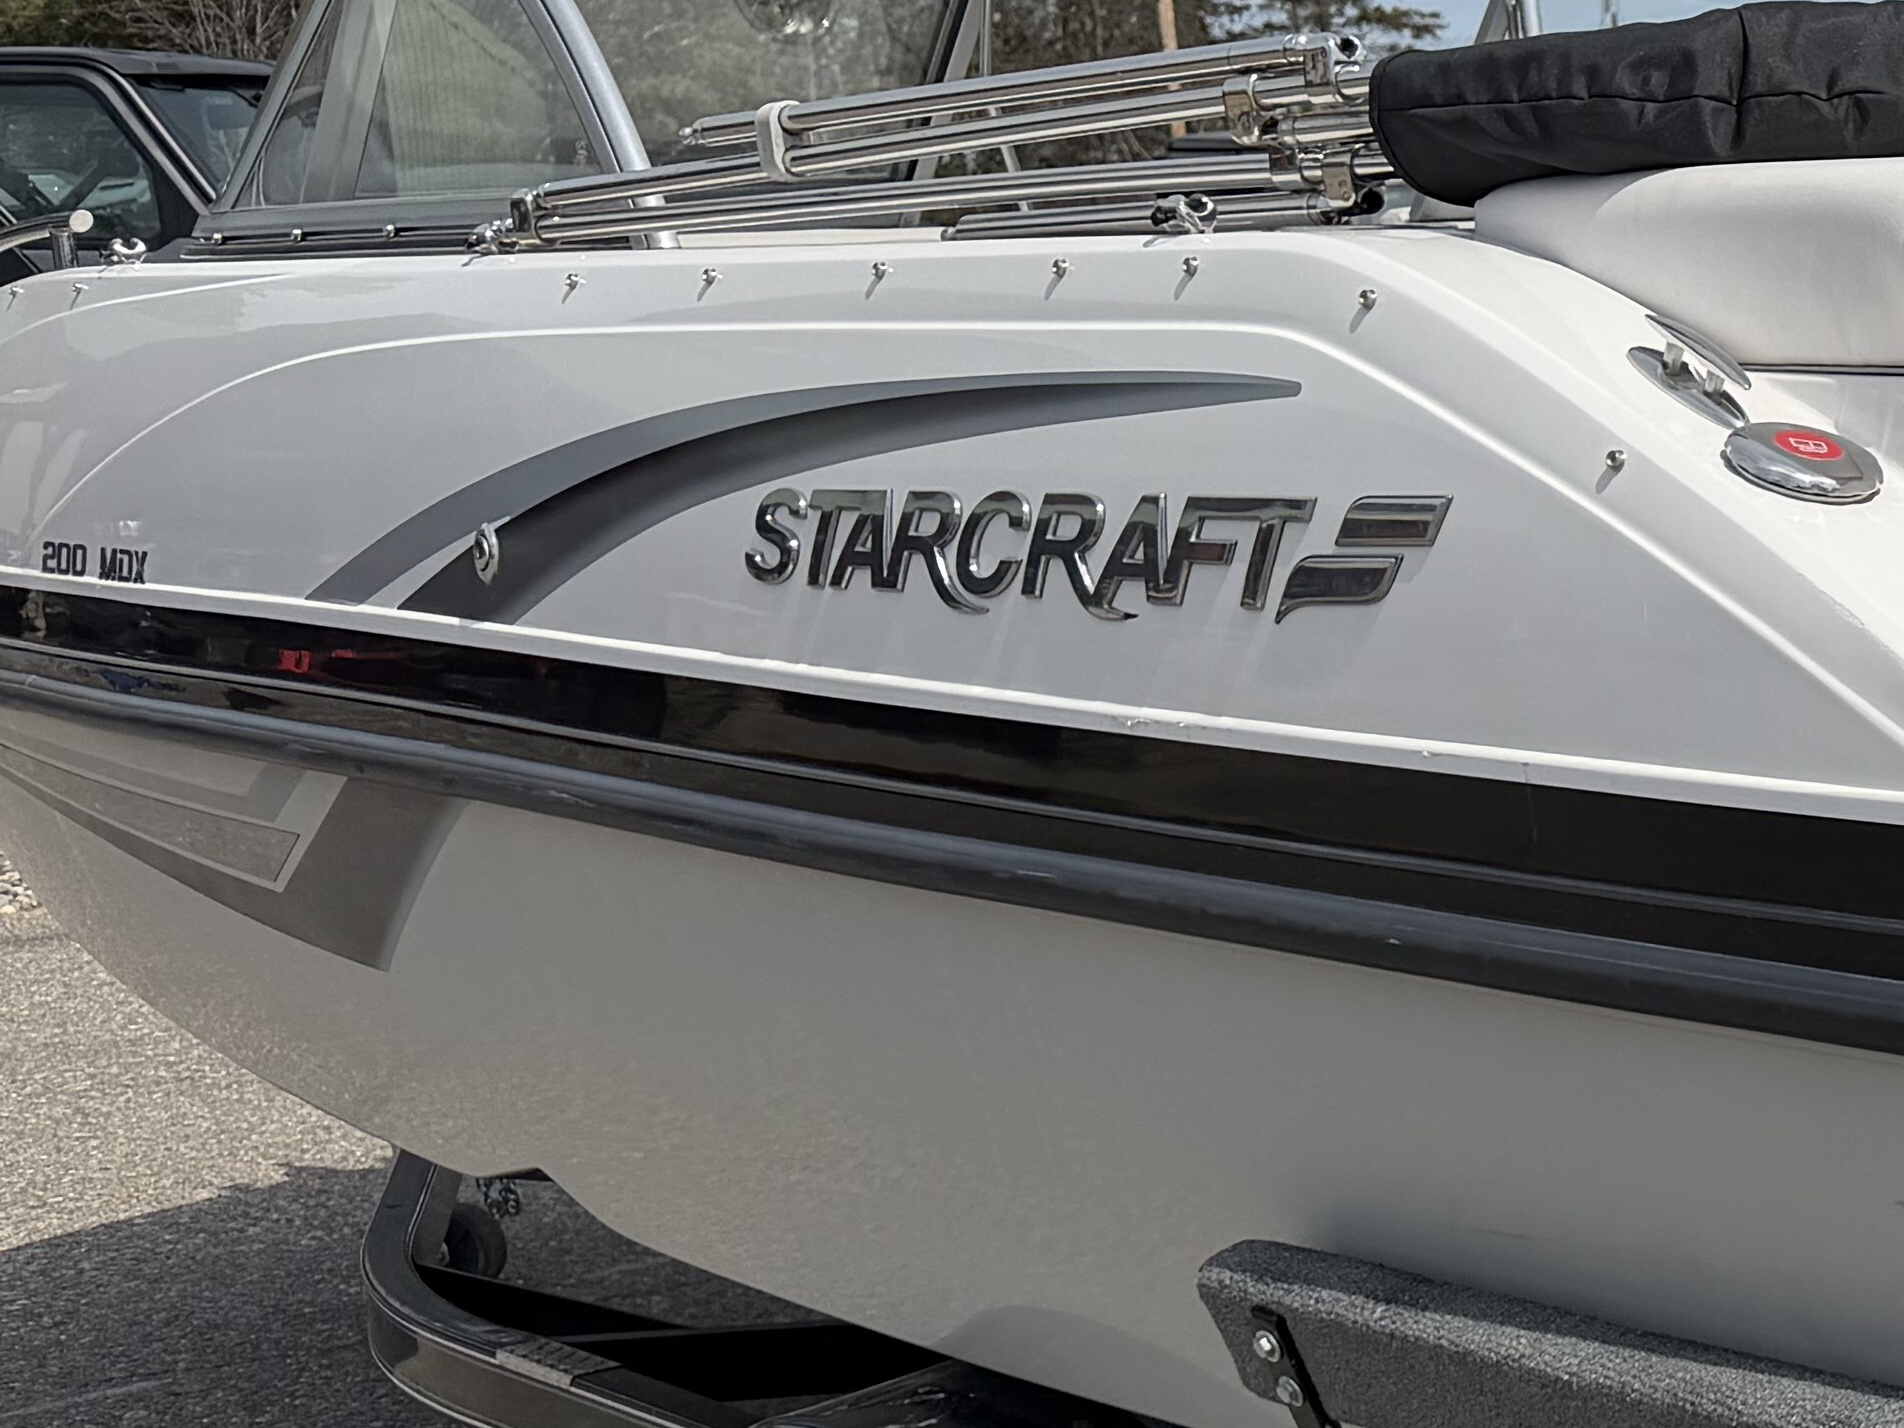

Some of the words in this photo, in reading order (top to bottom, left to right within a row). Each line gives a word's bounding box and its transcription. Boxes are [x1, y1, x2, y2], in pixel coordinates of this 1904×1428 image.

[42, 541, 87, 577] 200
[98, 546, 148, 585] MDX
[745, 486, 1318, 622] STARCRAFT
